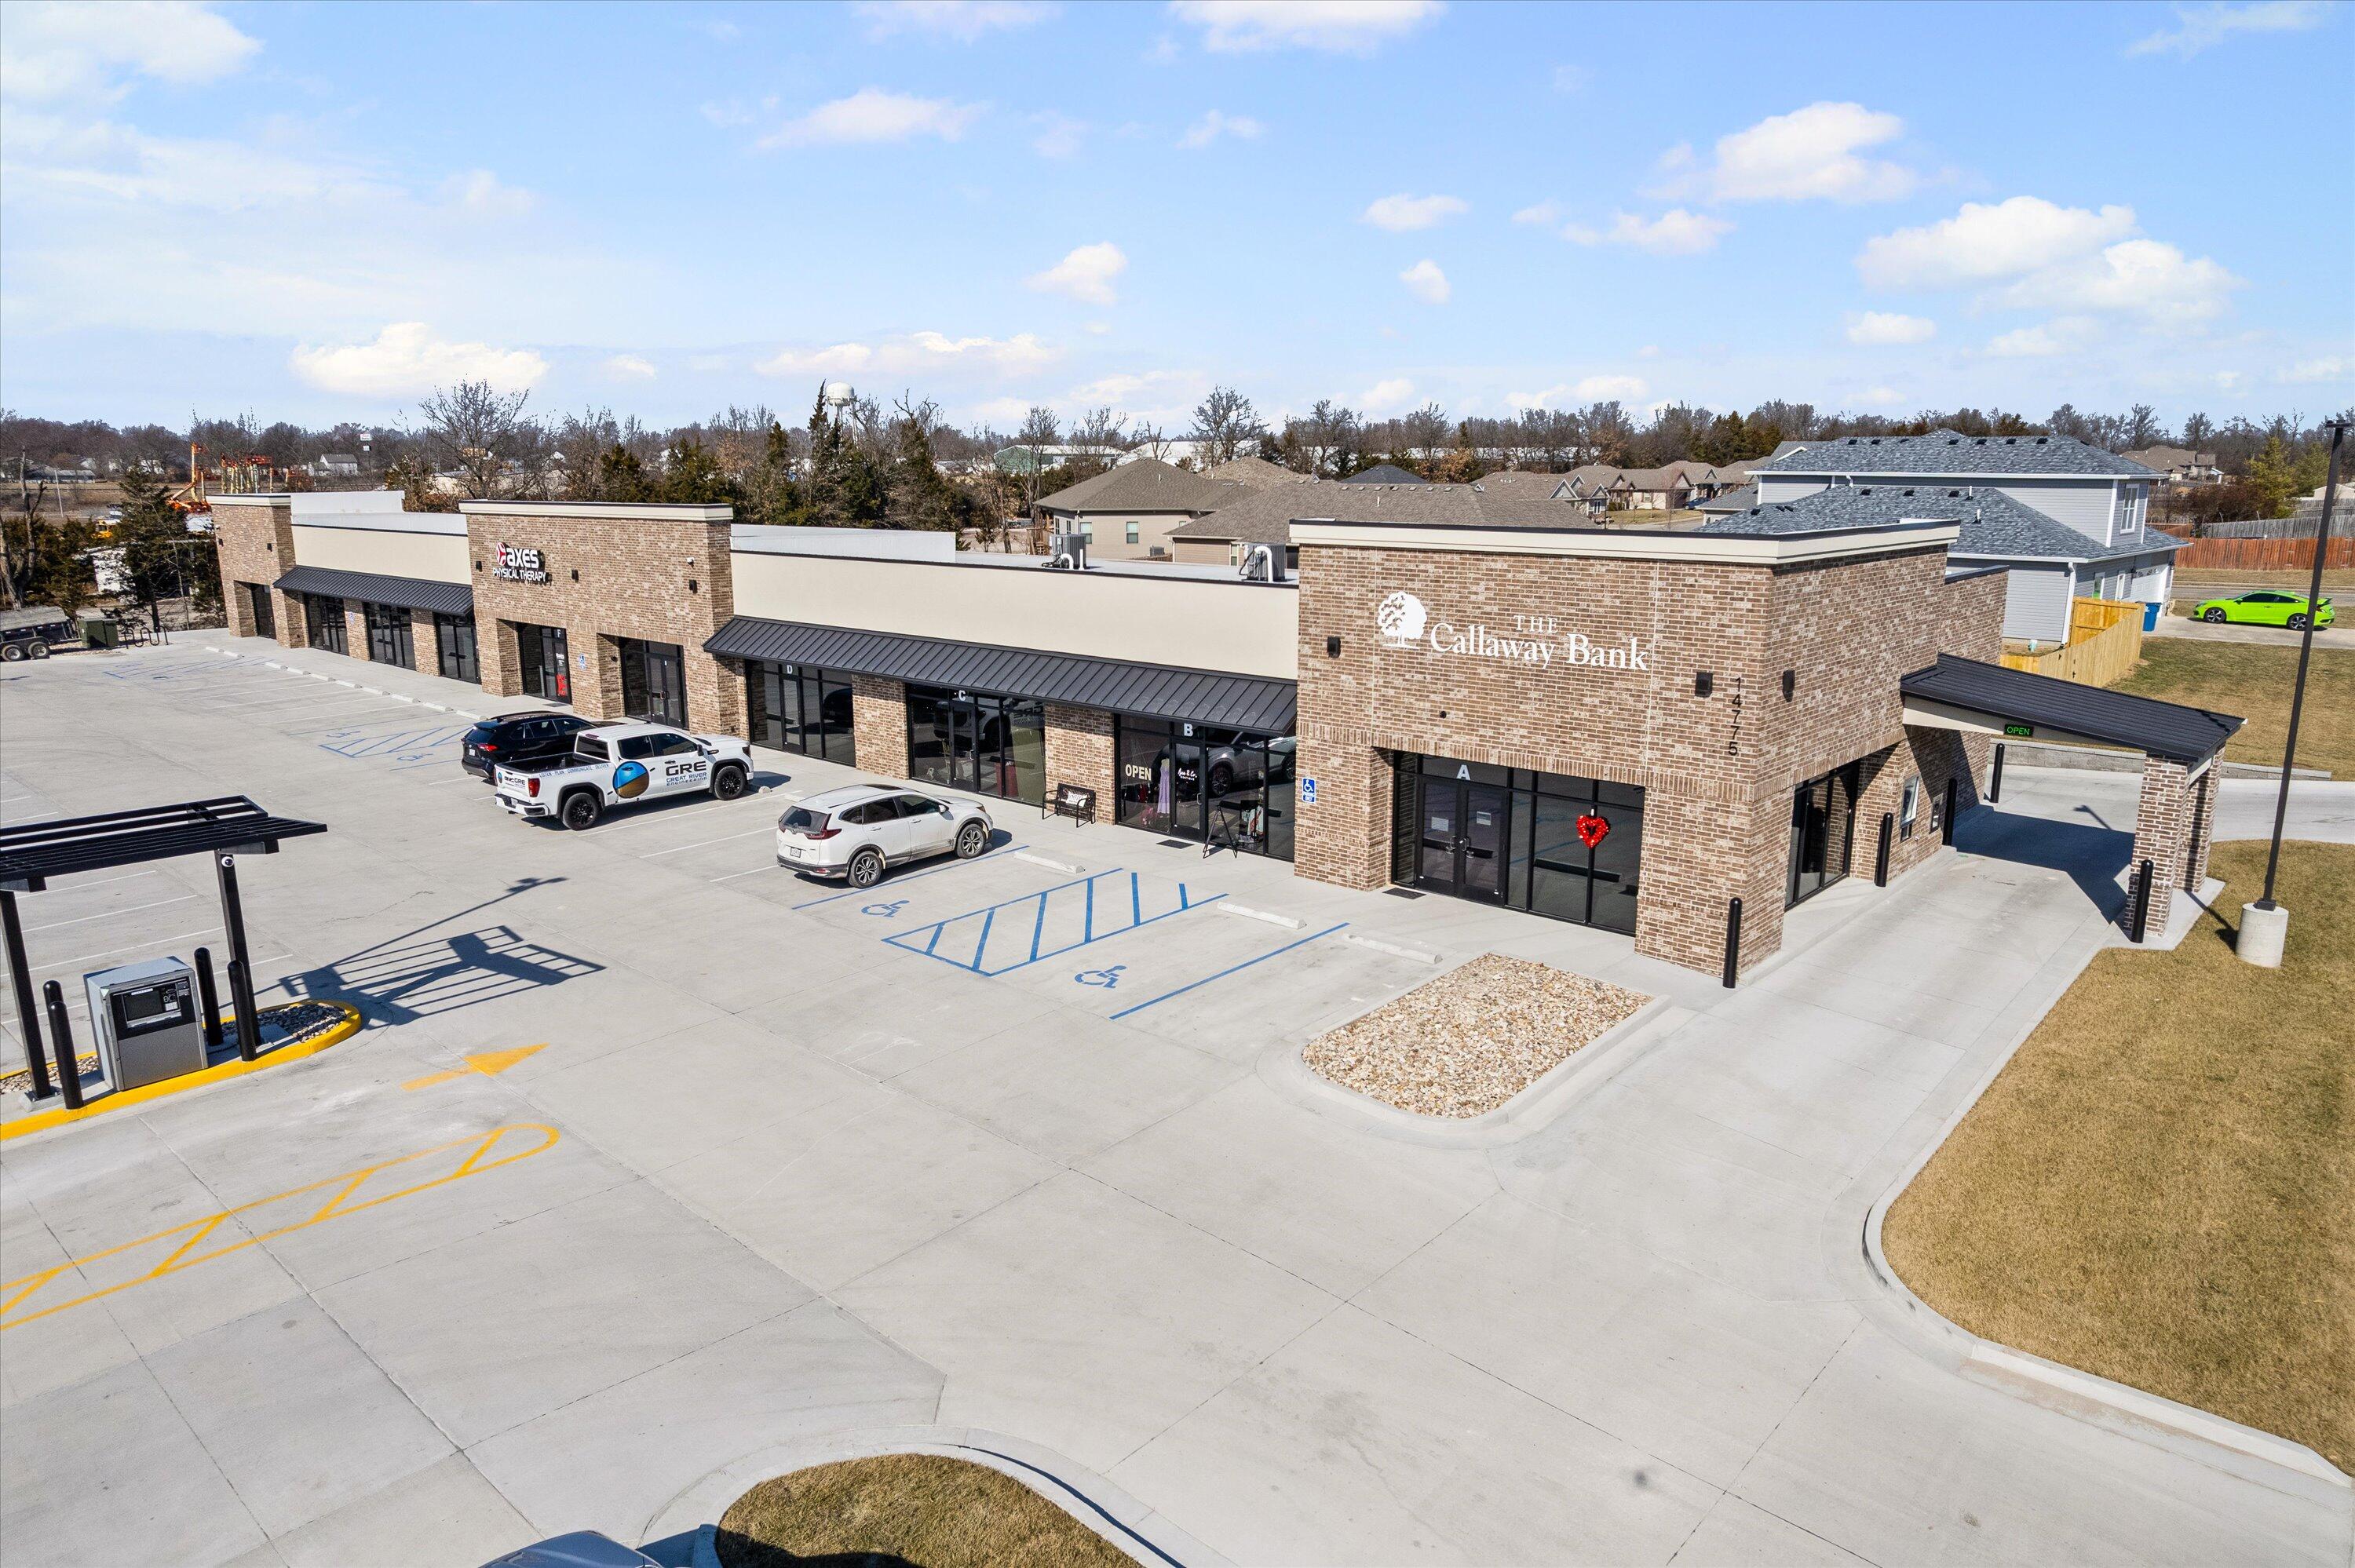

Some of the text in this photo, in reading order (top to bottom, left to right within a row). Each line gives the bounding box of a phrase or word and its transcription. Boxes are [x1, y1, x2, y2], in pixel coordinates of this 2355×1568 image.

[492, 567, 546, 582] PHYSICAL THERAPY
[1513, 614, 1558, 634] THE
[1430, 622, 1648, 671] Callaway Bank
[787, 665, 793, 674] D
[958, 690, 966, 702] C
[1184, 723, 1193, 737] B
[2006, 726, 2030, 735] OPEN
[666, 760, 706, 776] GRE
[1125, 764, 1152, 781] OPEN
[1456, 764, 1471, 781] A
